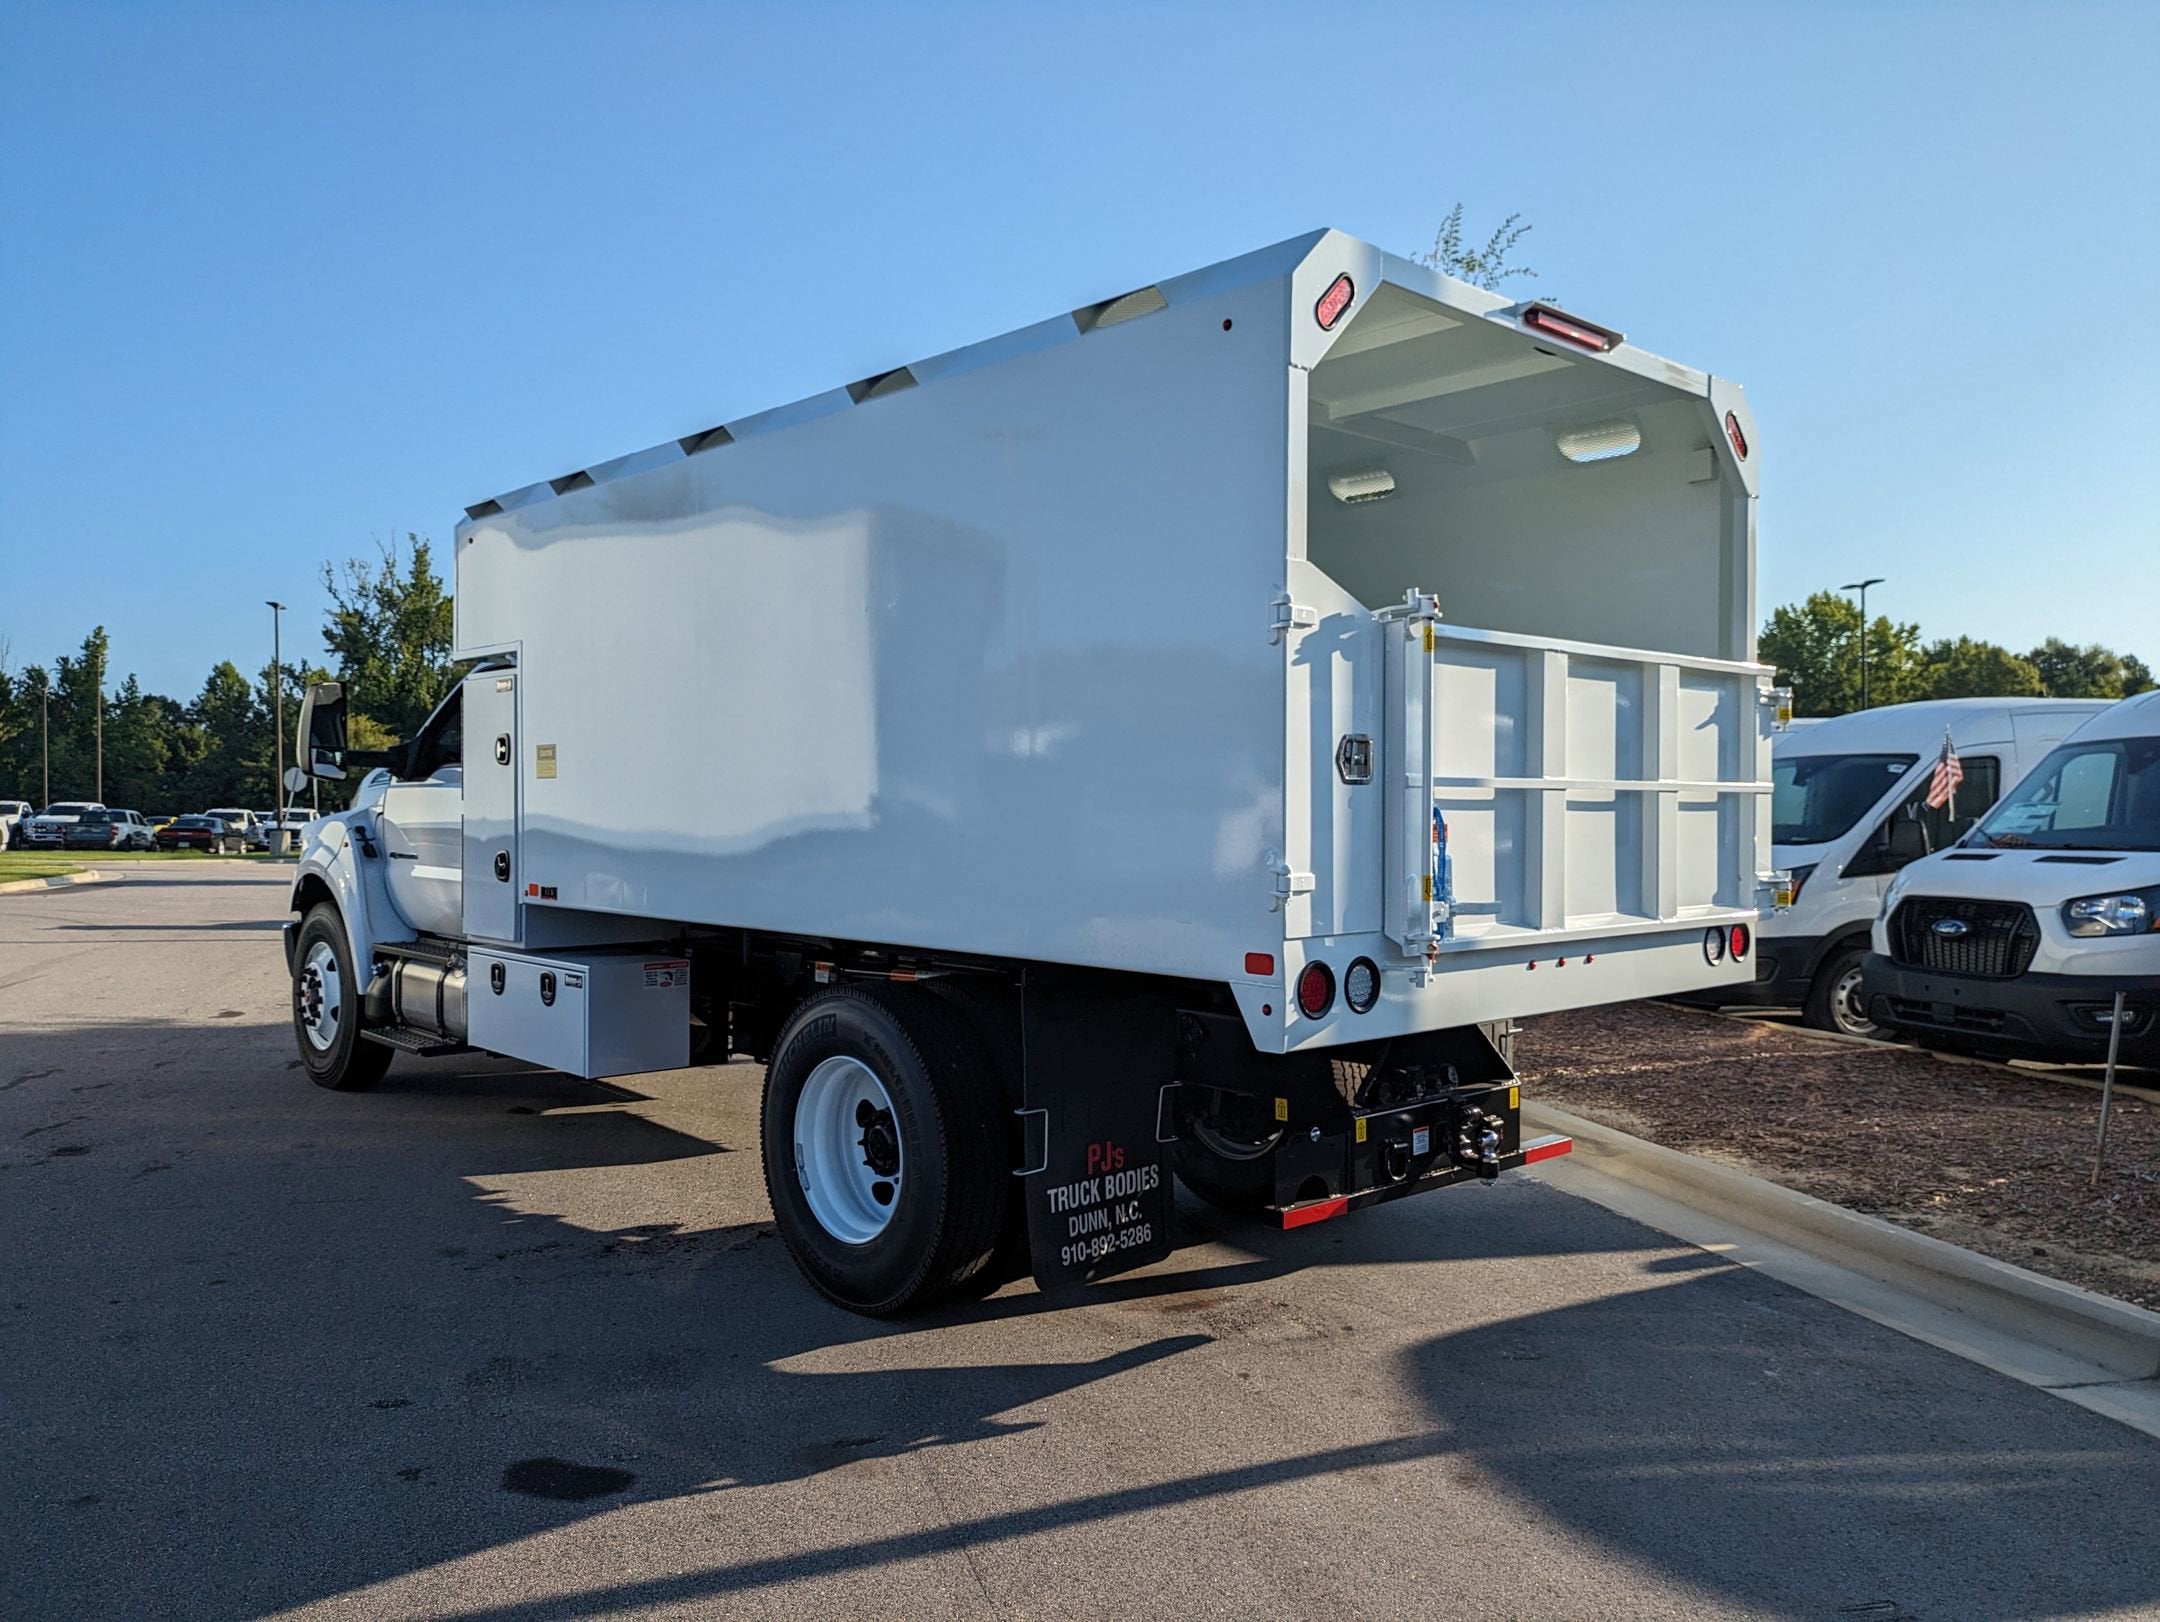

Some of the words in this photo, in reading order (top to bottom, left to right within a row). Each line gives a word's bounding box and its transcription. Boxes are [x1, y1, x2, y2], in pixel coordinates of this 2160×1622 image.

[1047, 1178, 1101, 1213] TRUCK
[1105, 1164, 1159, 1200] BODIES
[1069, 1207, 1112, 1237] DUNN,
[1115, 1200, 1143, 1224] N.C.
[1061, 1223, 1152, 1266] 910-892-5286
